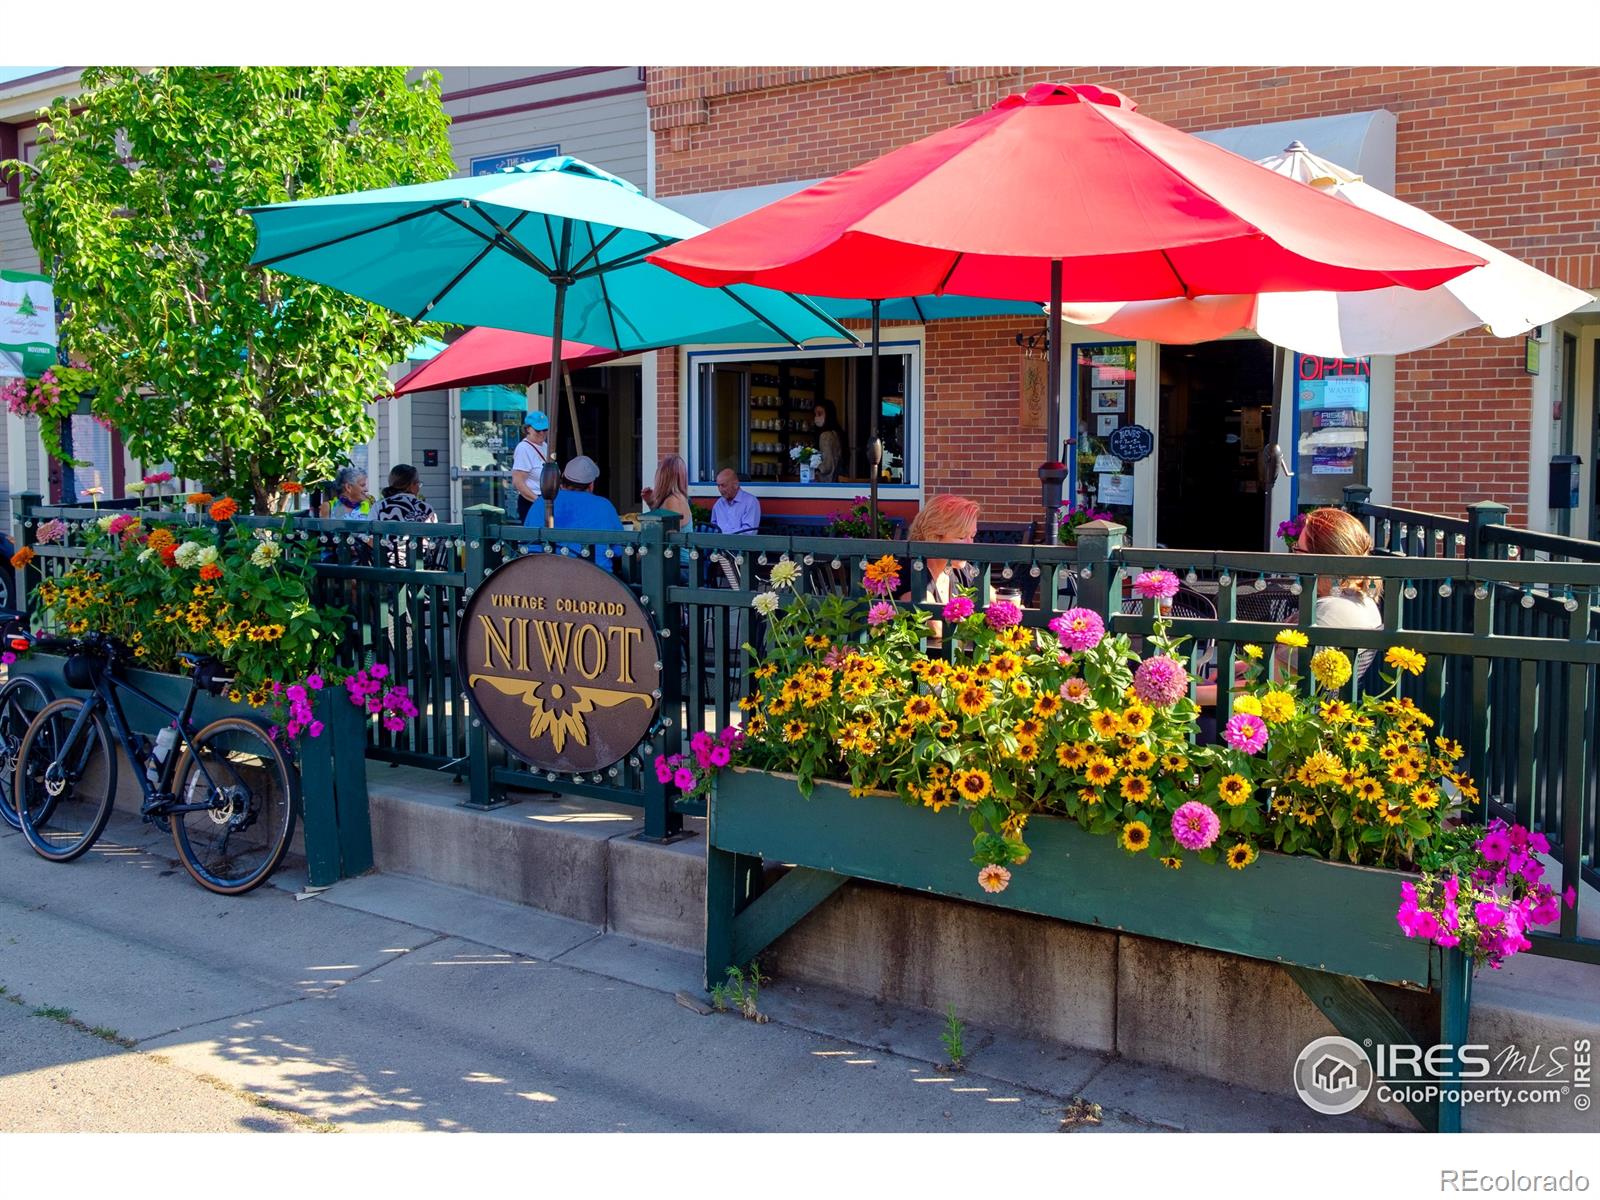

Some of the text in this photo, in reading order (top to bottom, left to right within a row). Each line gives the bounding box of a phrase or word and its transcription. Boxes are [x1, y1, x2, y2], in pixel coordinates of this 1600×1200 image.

[491, 594, 625, 616] VINTAGE COLORADO
[478, 615, 642, 684] NIWOT
